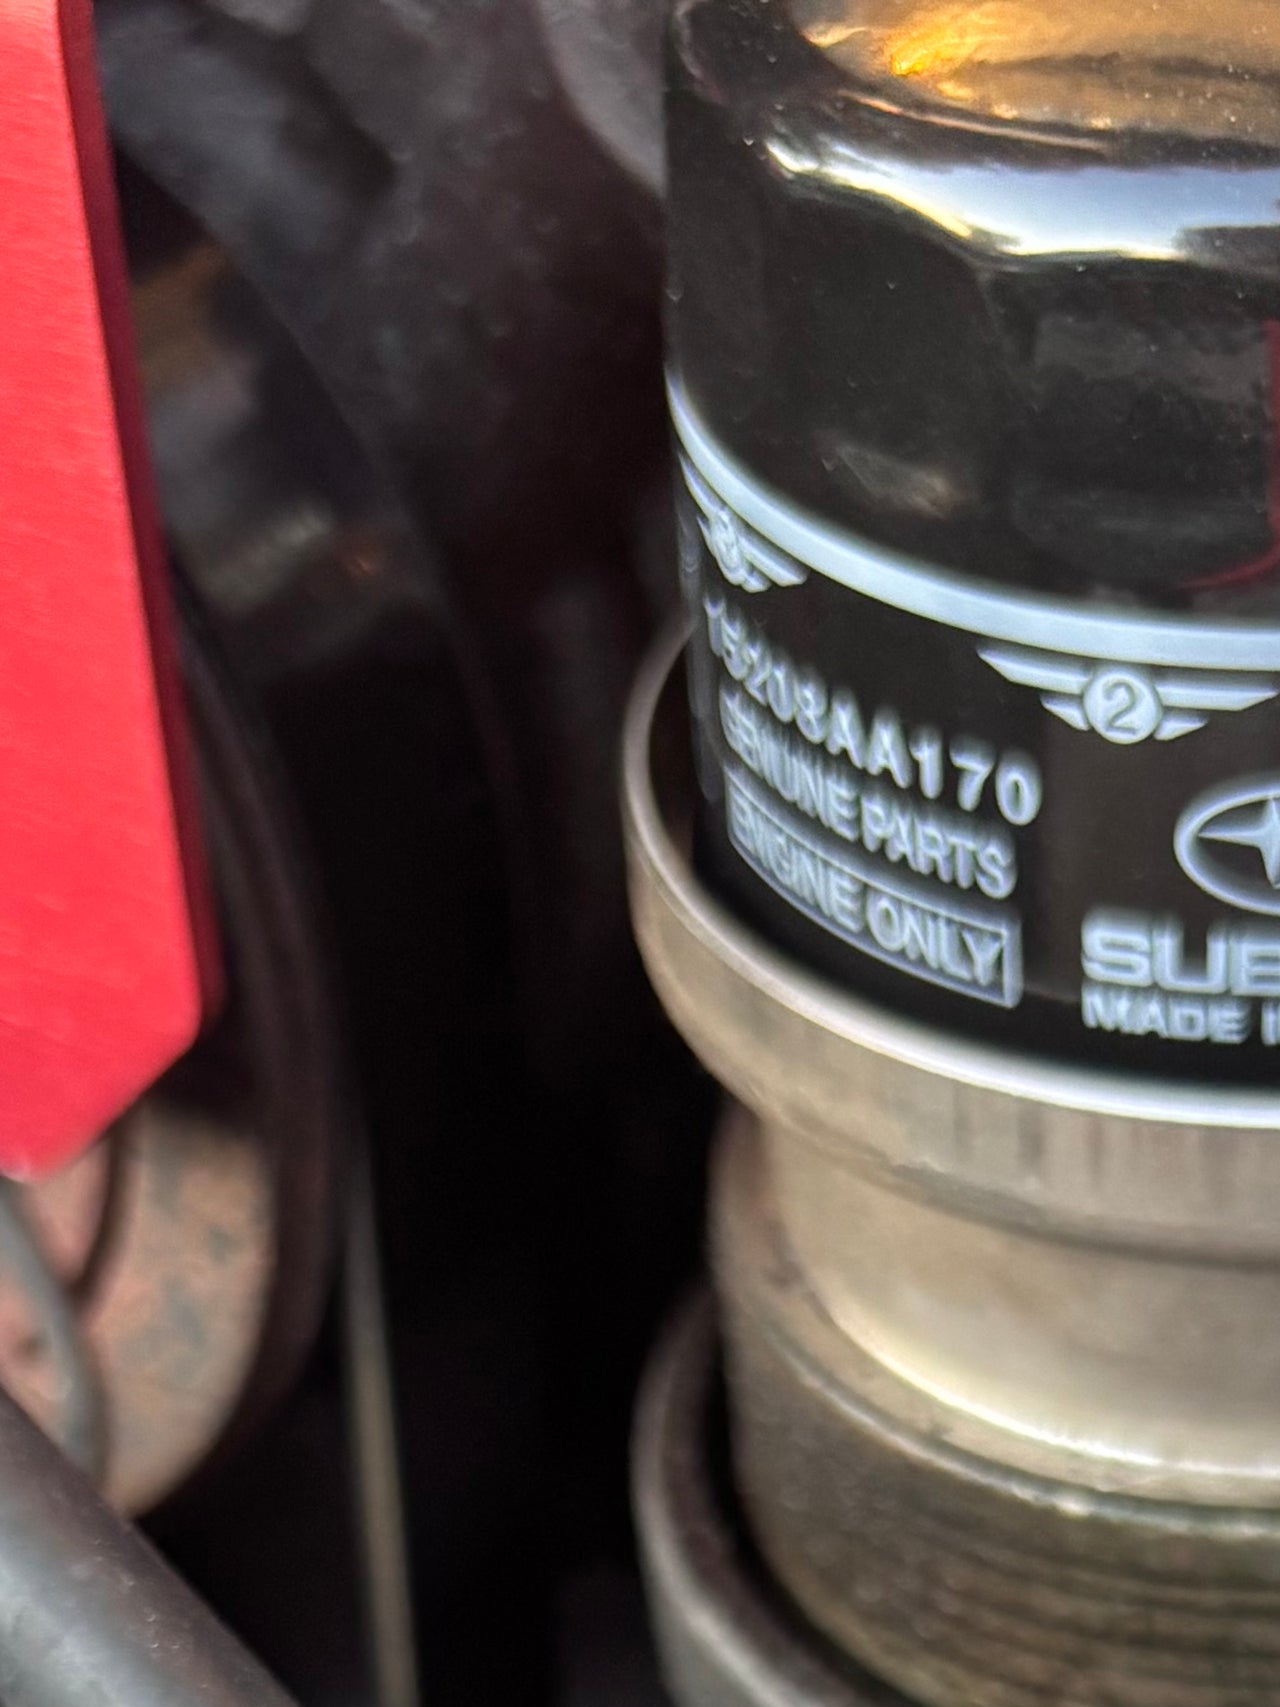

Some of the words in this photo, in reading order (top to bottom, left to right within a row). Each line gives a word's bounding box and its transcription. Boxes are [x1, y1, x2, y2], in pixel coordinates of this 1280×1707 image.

[861, 789, 1016, 900] PARTS
[866, 886, 1003, 987] ONLY
[1082, 984, 1249, 1045] MADE
